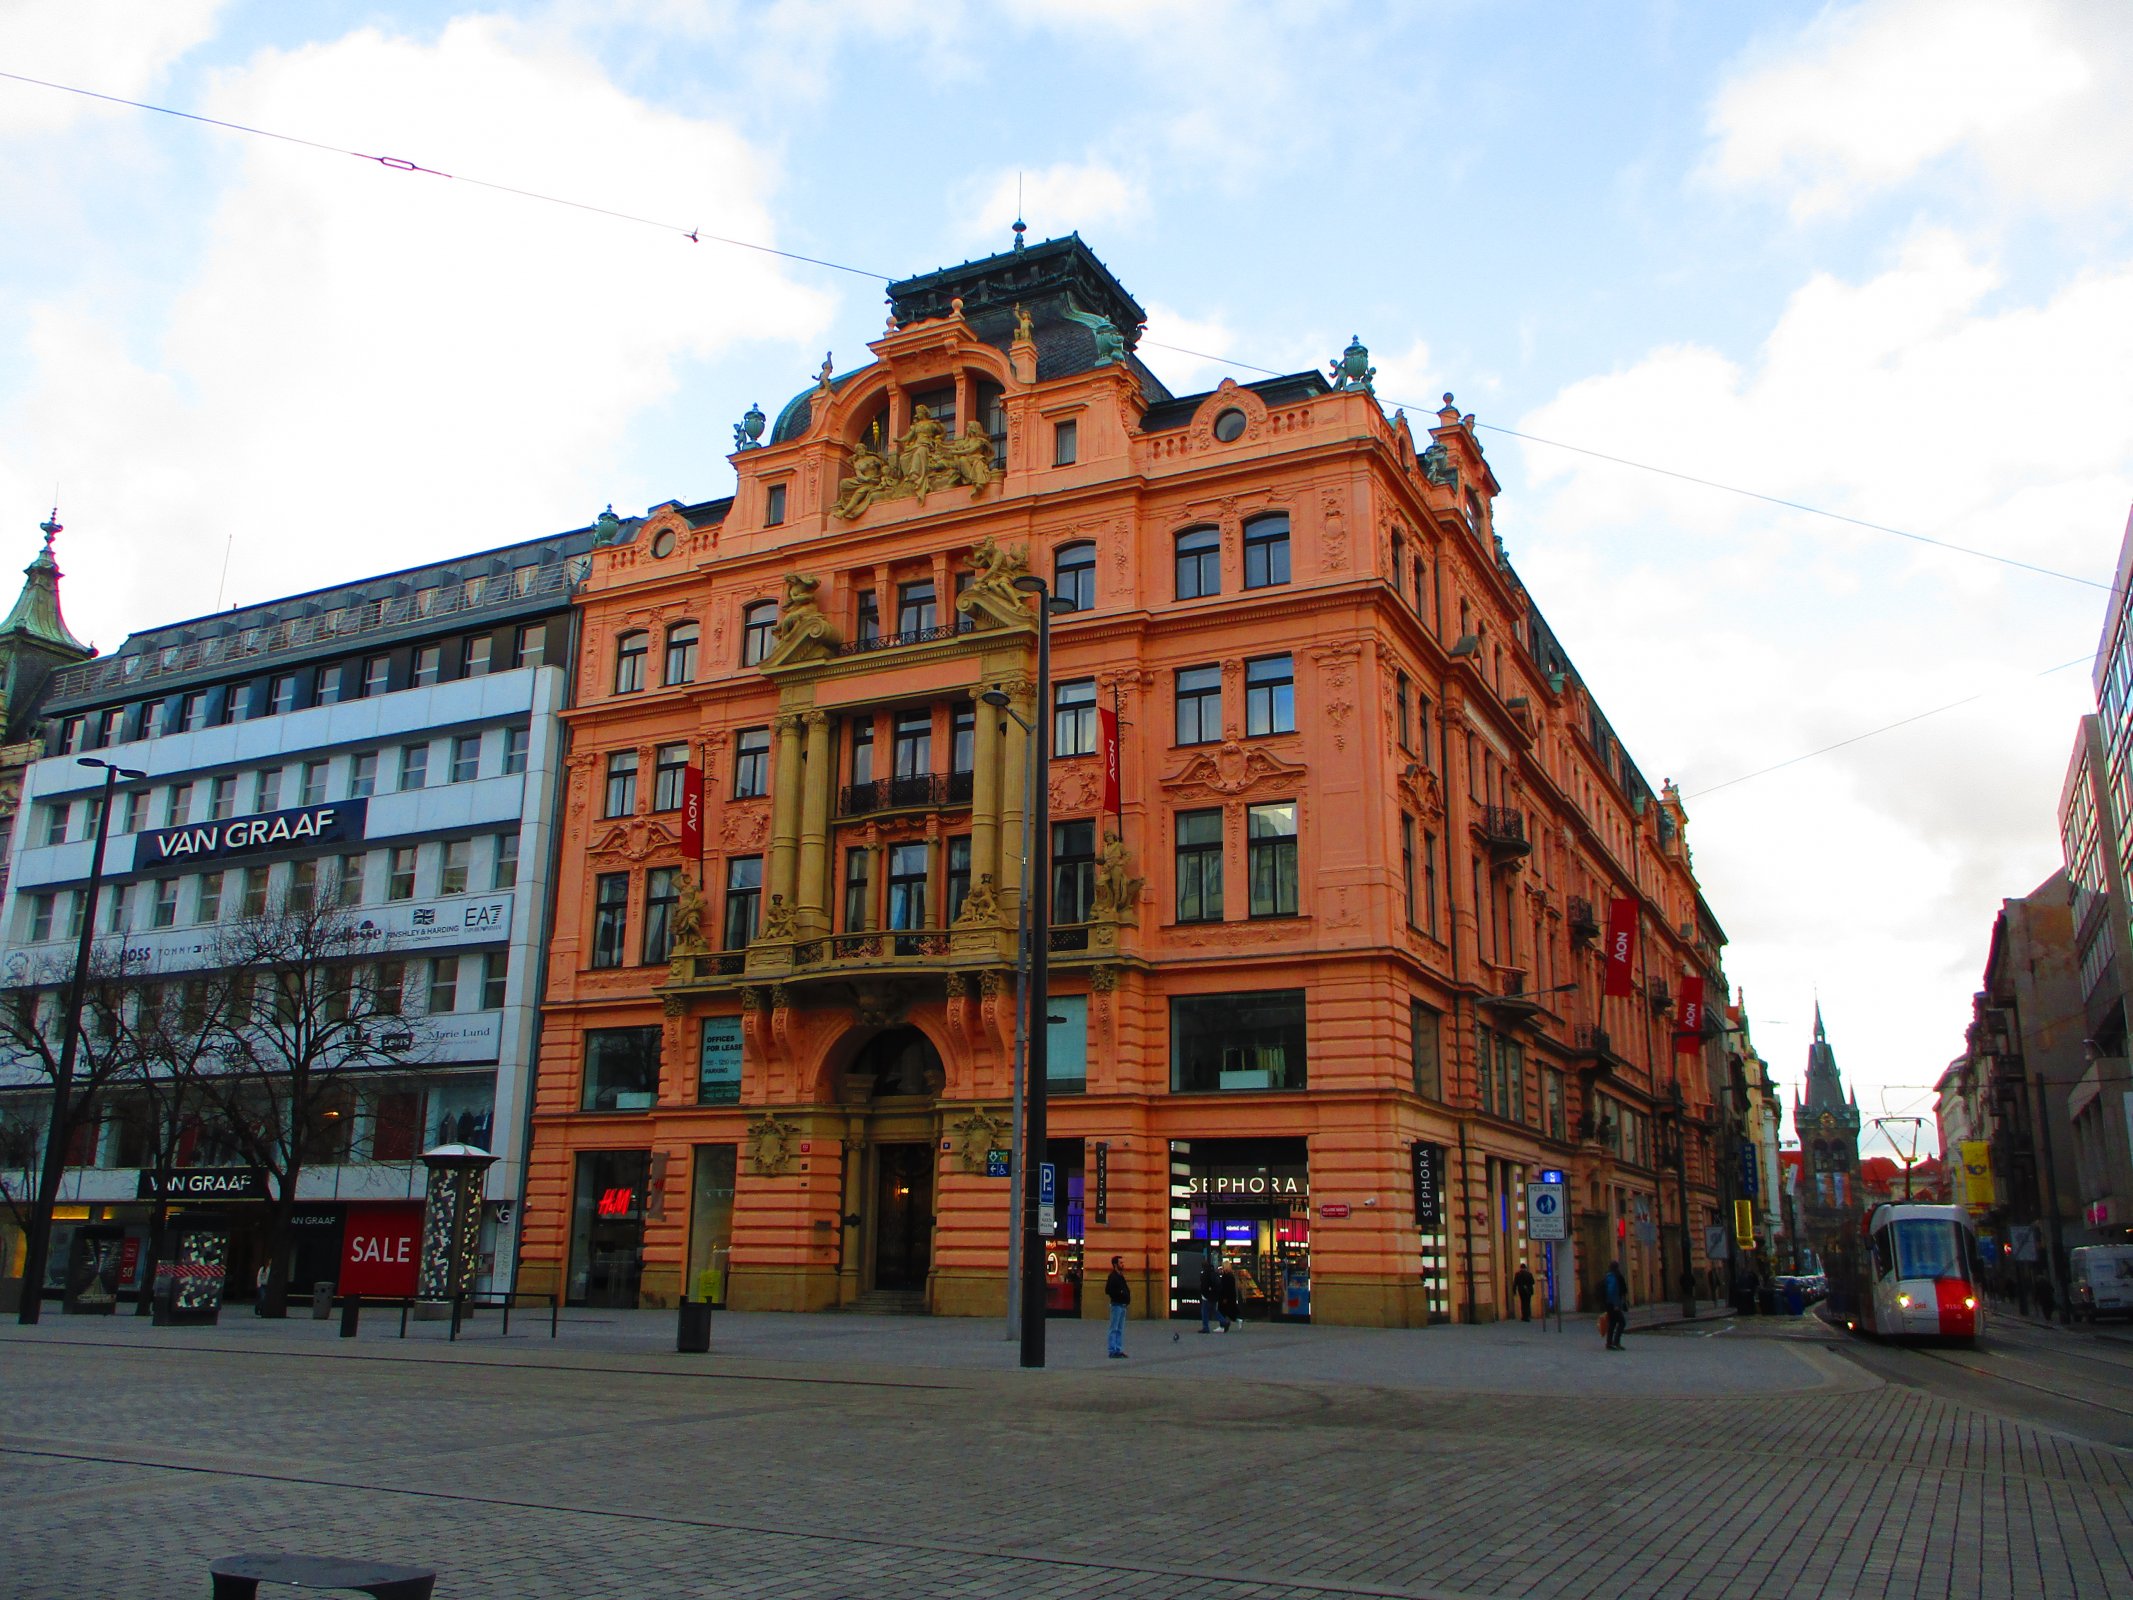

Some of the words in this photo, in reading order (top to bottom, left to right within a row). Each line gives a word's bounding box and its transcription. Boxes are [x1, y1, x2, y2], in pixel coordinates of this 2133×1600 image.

[687, 794, 698, 831] AON
[157, 827, 218, 857] VAN
[225, 810, 334, 848] GRAAF
[465, 905, 503, 926] EA7
[159, 947, 191, 956] TOMMY
[1614, 932, 1628, 963] AON
[1684, 1002, 1696, 1028] AON
[463, 1027, 490, 1037] Lund
[706, 1035, 735, 1043] OFFICES
[189, 1175, 251, 1191] GRAAF
[1043, 1168, 1052, 1191] P
[1189, 1177, 1298, 1193] SEPHORA
[1419, 1149, 1432, 1216] SEPHORA
[598, 1188, 632, 1215] H&M
[305, 1216, 336, 1225] GRAAF
[351, 1236, 411, 1262] SALE
